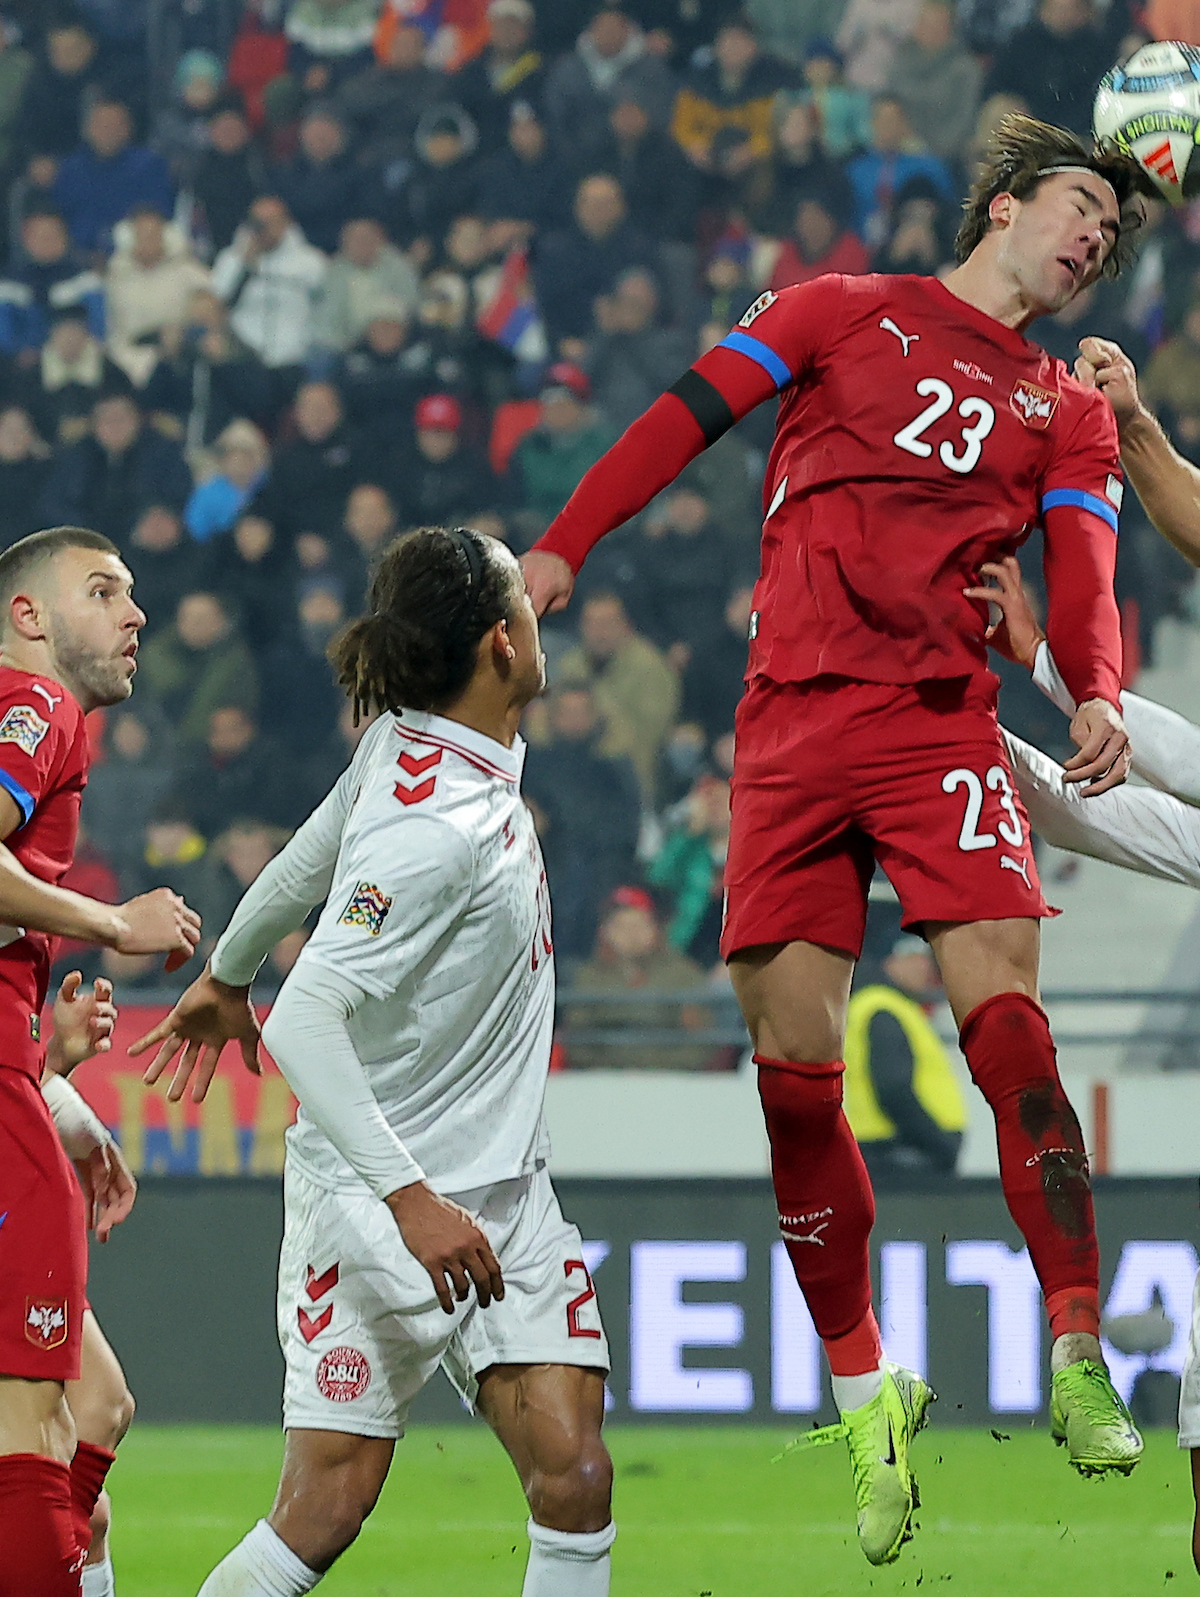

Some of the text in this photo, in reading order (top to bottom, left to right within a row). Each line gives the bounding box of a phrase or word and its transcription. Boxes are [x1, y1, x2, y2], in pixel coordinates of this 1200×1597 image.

[892, 376, 996, 475] 23
[942, 765, 1023, 852] 23
[326, 1363, 359, 1384] DBU
